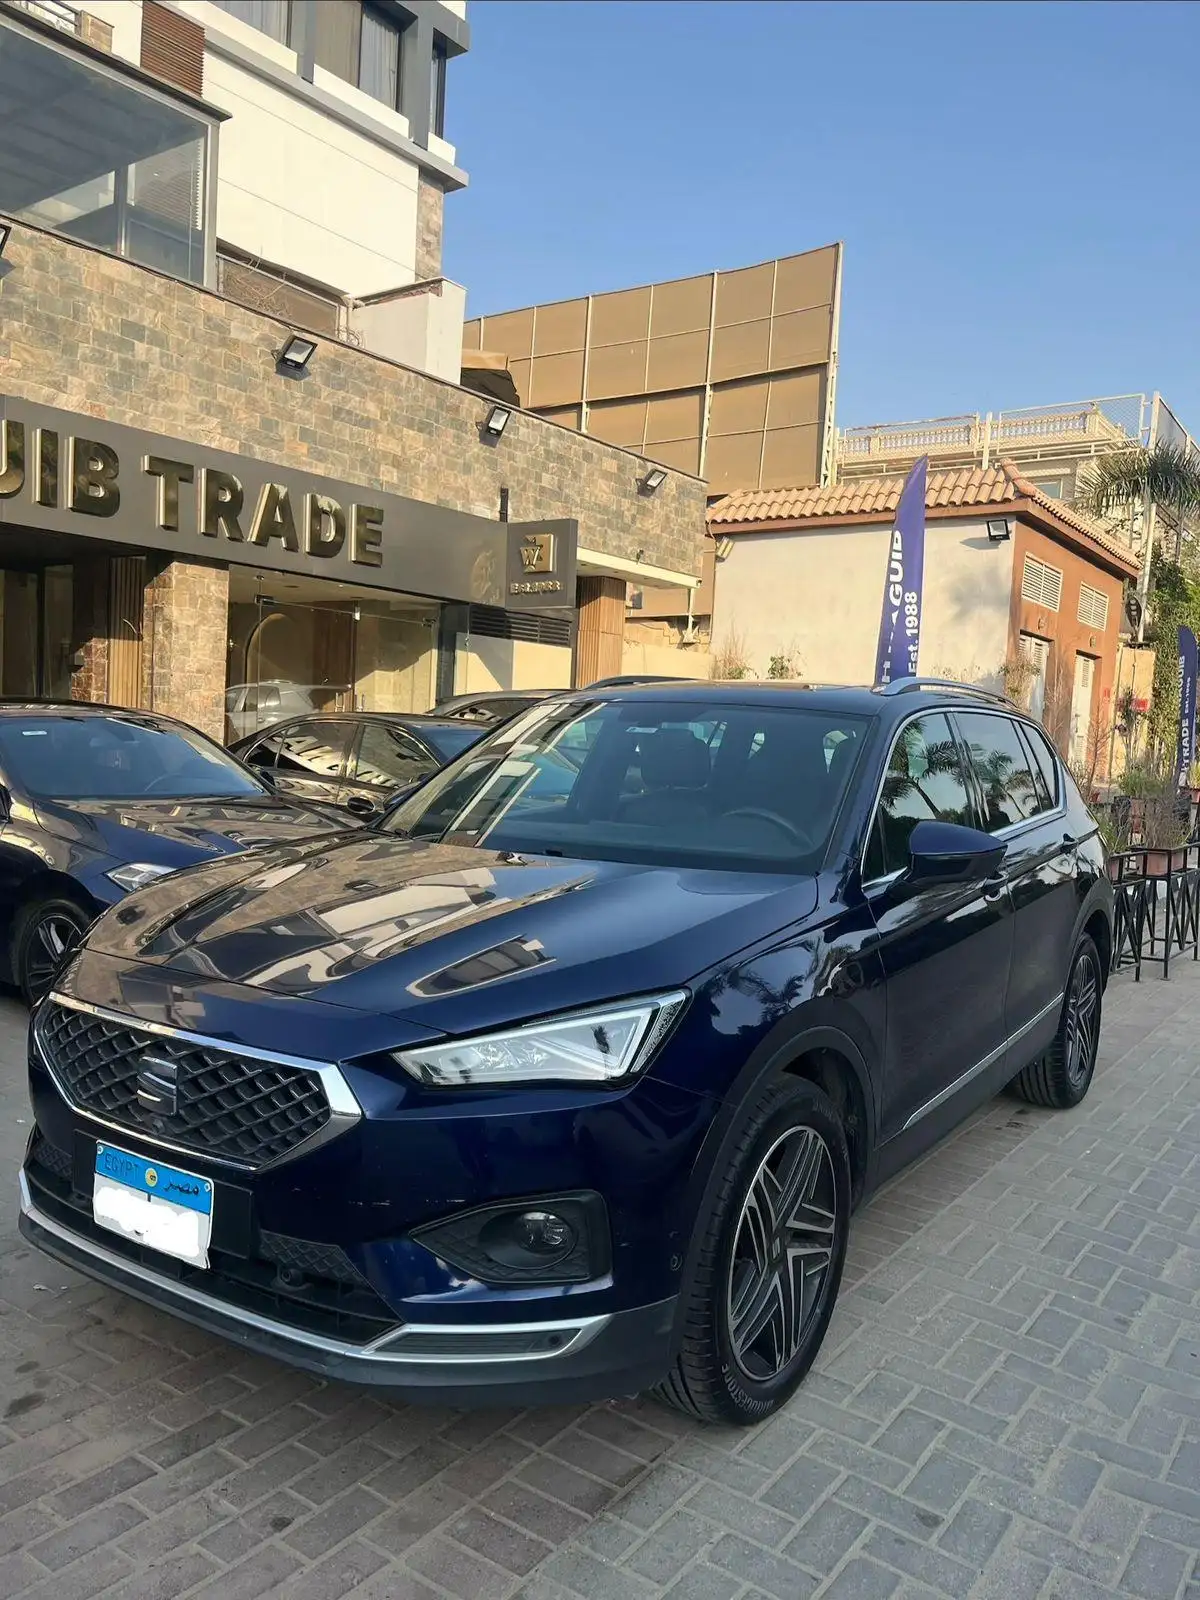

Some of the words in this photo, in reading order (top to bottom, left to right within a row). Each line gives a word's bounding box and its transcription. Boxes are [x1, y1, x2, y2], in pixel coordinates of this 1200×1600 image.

[142, 454, 384, 567] TRADE
[904, 591, 918, 636] 1988
[104, 1152, 139, 1180] EGYPT
[163, 1179, 199, 1195] مصر
